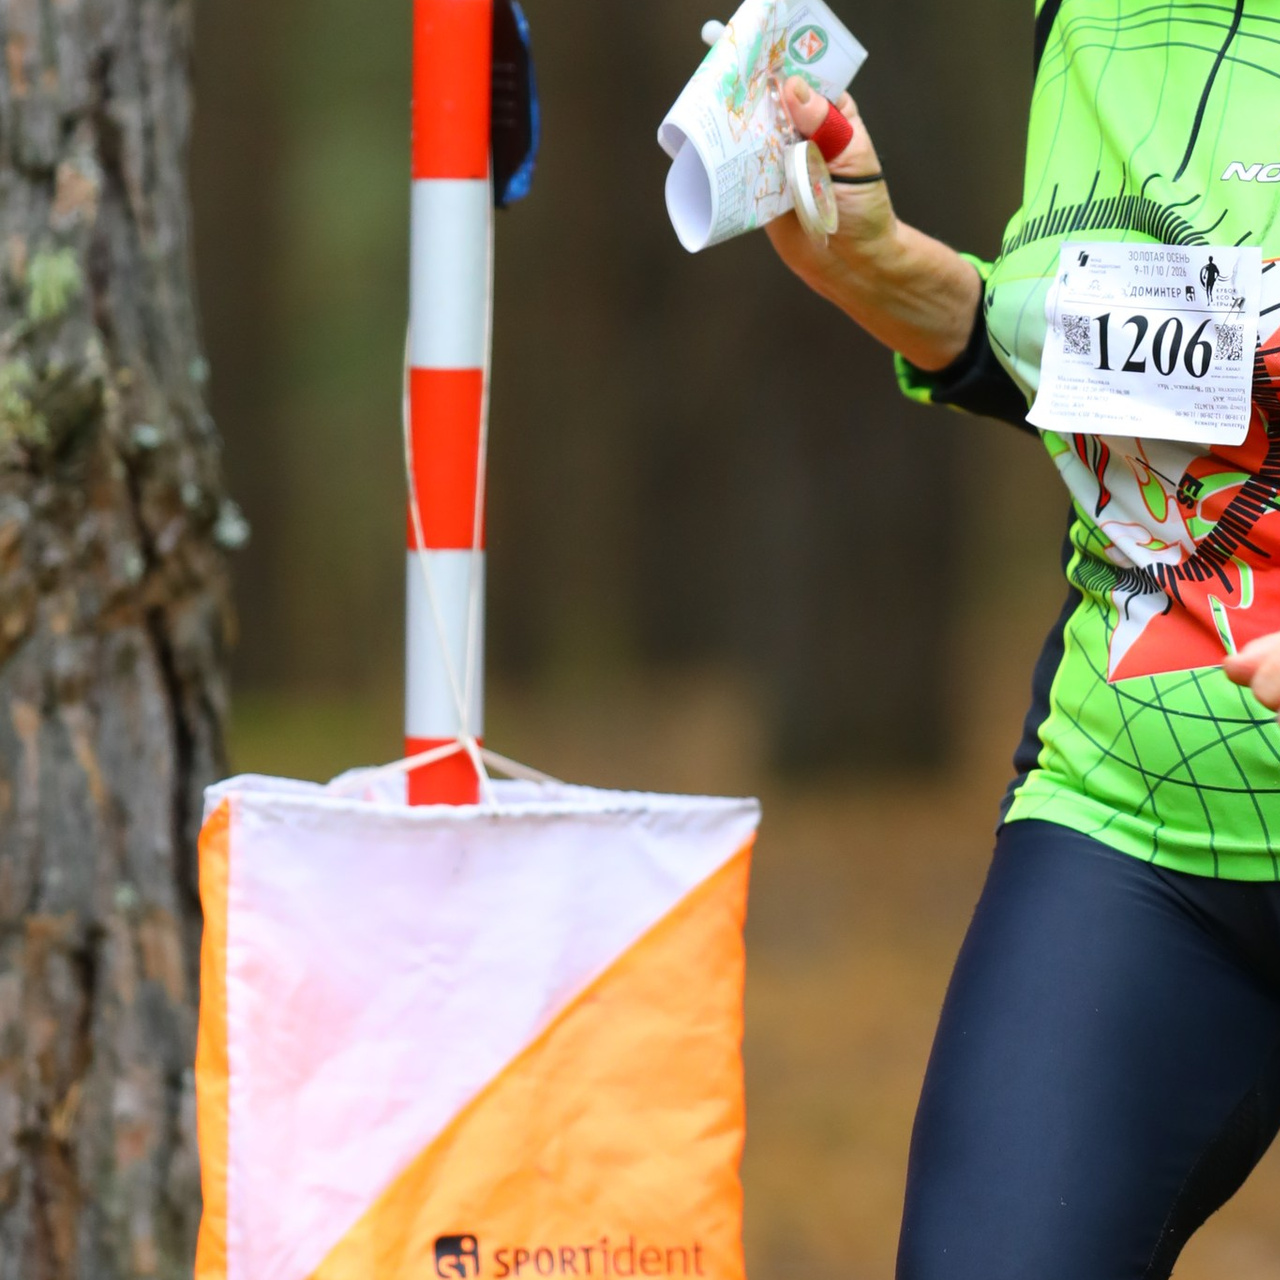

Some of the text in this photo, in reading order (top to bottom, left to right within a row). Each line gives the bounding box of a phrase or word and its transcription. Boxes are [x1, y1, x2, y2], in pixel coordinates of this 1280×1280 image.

[1128, 250, 1190, 263] ЗОЛОТАЯ ОСЕНЬ
[1134, 265, 1149, 275] 9-11
[1156, 266, 1164, 277] 10
[1130, 286, 1182, 299] ДОМИНТЕР
[1092, 312, 1213, 378] 1206
[493, 1234, 706, 1279] SPORTident
